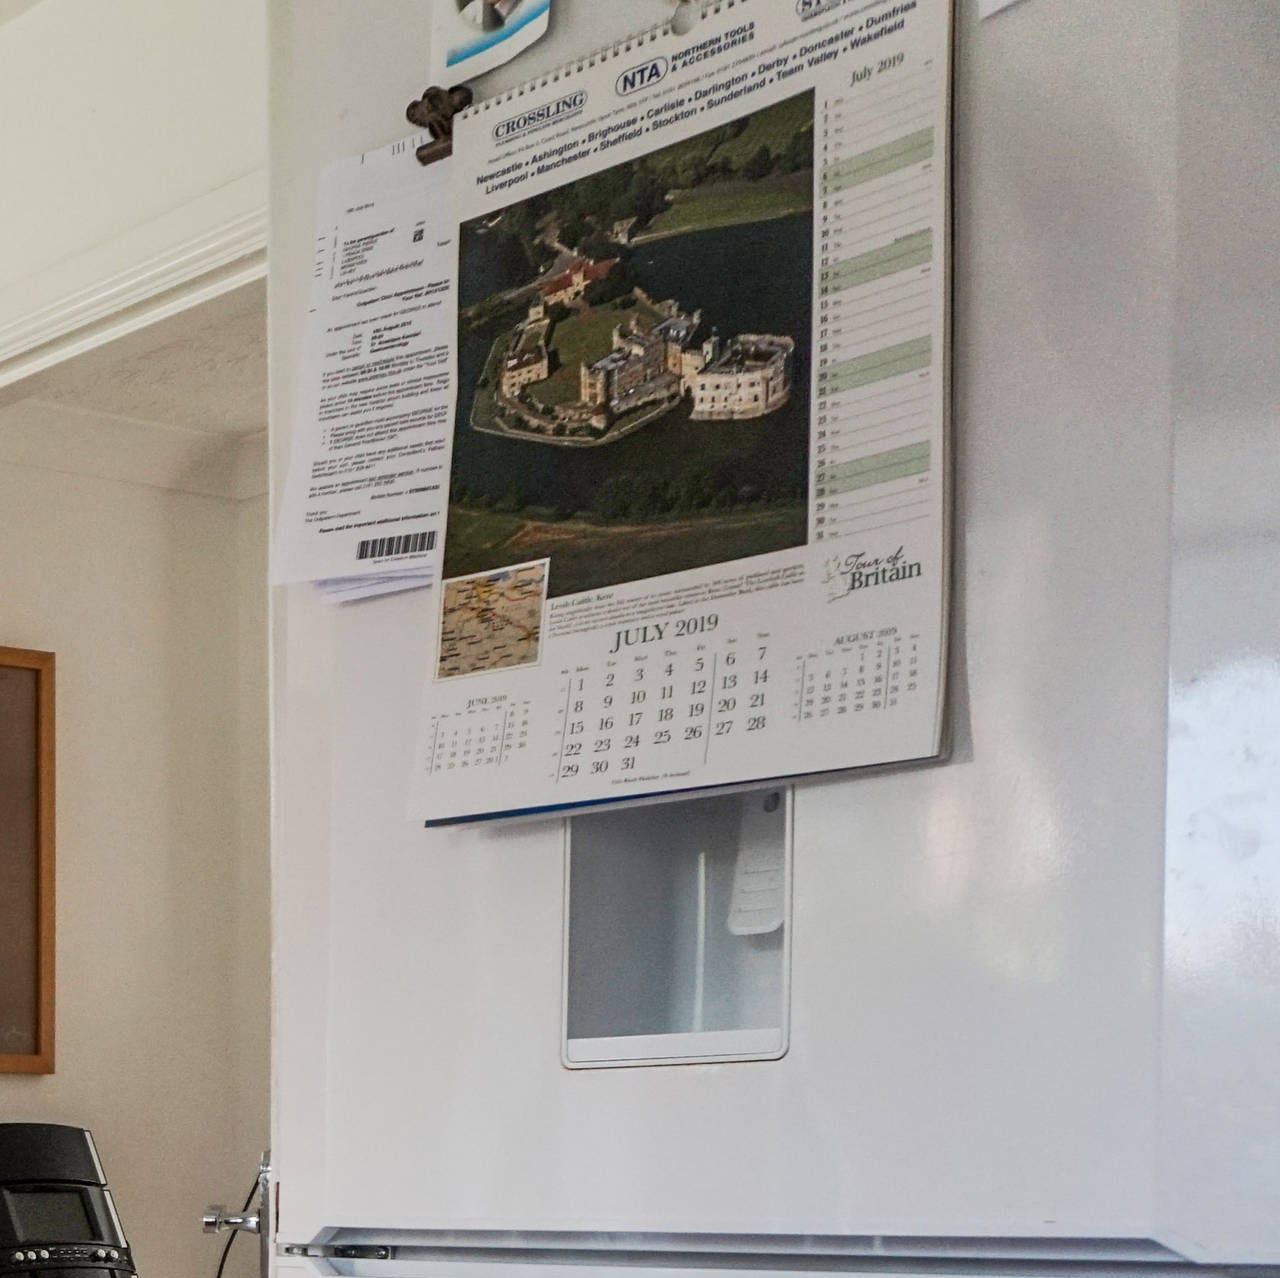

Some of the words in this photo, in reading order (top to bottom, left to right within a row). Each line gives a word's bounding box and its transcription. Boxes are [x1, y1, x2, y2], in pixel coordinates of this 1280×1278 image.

[671, 35, 722, 63] NORTHERN
[724, 21, 755, 40] TOOLS
[681, 31, 755, 68] ACCESSORIES
[622, 62, 662, 93] NTA
[850, 66, 873, 87] July
[877, 52, 905, 74] 2019
[476, 160, 523, 185] Newcastle
[530, 141, 580, 165] Ashington
[587, 115, 638, 144] Brighouse
[646, 97, 685, 120] Carlisle
[694, 72, 748, 101] Darlington
[757, 55, 790, 75] Derby
[799, 26, 856, 58] Doncaster
[865, 1, 917, 30] Dumfries
[484, 171, 529, 195] Liverpool
[536, 148, 591, 176] Manchester
[599, 127, 643, 152] Sheffield
[651, 107, 697, 132] Stockton
[707, 78, 766, 110] Sunderland
[776, 64, 804, 82] Team
[807, 49, 840, 67] Valley
[850, 18, 905, 50] Wakefield
[494, 92, 585, 138] CROSSLING
[840, 552, 882, 575] Tour
[886, 546, 904, 566] of
[848, 561, 922, 590] Britain
[610, 622, 670, 653] JULY
[675, 614, 719, 637] 2019
[578, 679, 583, 691] 1
[606, 674, 615, 687] 2
[634, 669, 644, 681] 3
[665, 663, 675, 677] 4
[696, 659, 704, 671] 5
[727, 653, 736, 665] 6
[759, 647, 767, 660] 7
[574, 701, 583, 713] 8
[603, 696, 613, 708] 9
[631, 691, 646, 704] 10
[661, 686, 673, 699] 11
[691, 681, 706, 695] 12
[722, 675, 737, 689] 13
[753, 670, 769, 684] 14
[570, 721, 584, 735] 15
[600, 717, 614, 730] 16
[629, 713, 643, 726] 17
[658, 708, 674, 721] 18
[688, 703, 704, 717] 19
[718, 698, 736, 712] 20
[750, 694, 765, 707] 21
[564, 743, 582, 756] 22
[594, 739, 610, 752] 23
[625, 735, 640, 748] 24
[654, 730, 671, 744] 25
[684, 726, 702, 740] 26
[715, 721, 733, 735] 27
[747, 717, 766, 731] 28
[561, 765, 579, 778] 29
[591, 761, 608, 774] 30
[621, 757, 635, 770] 31
